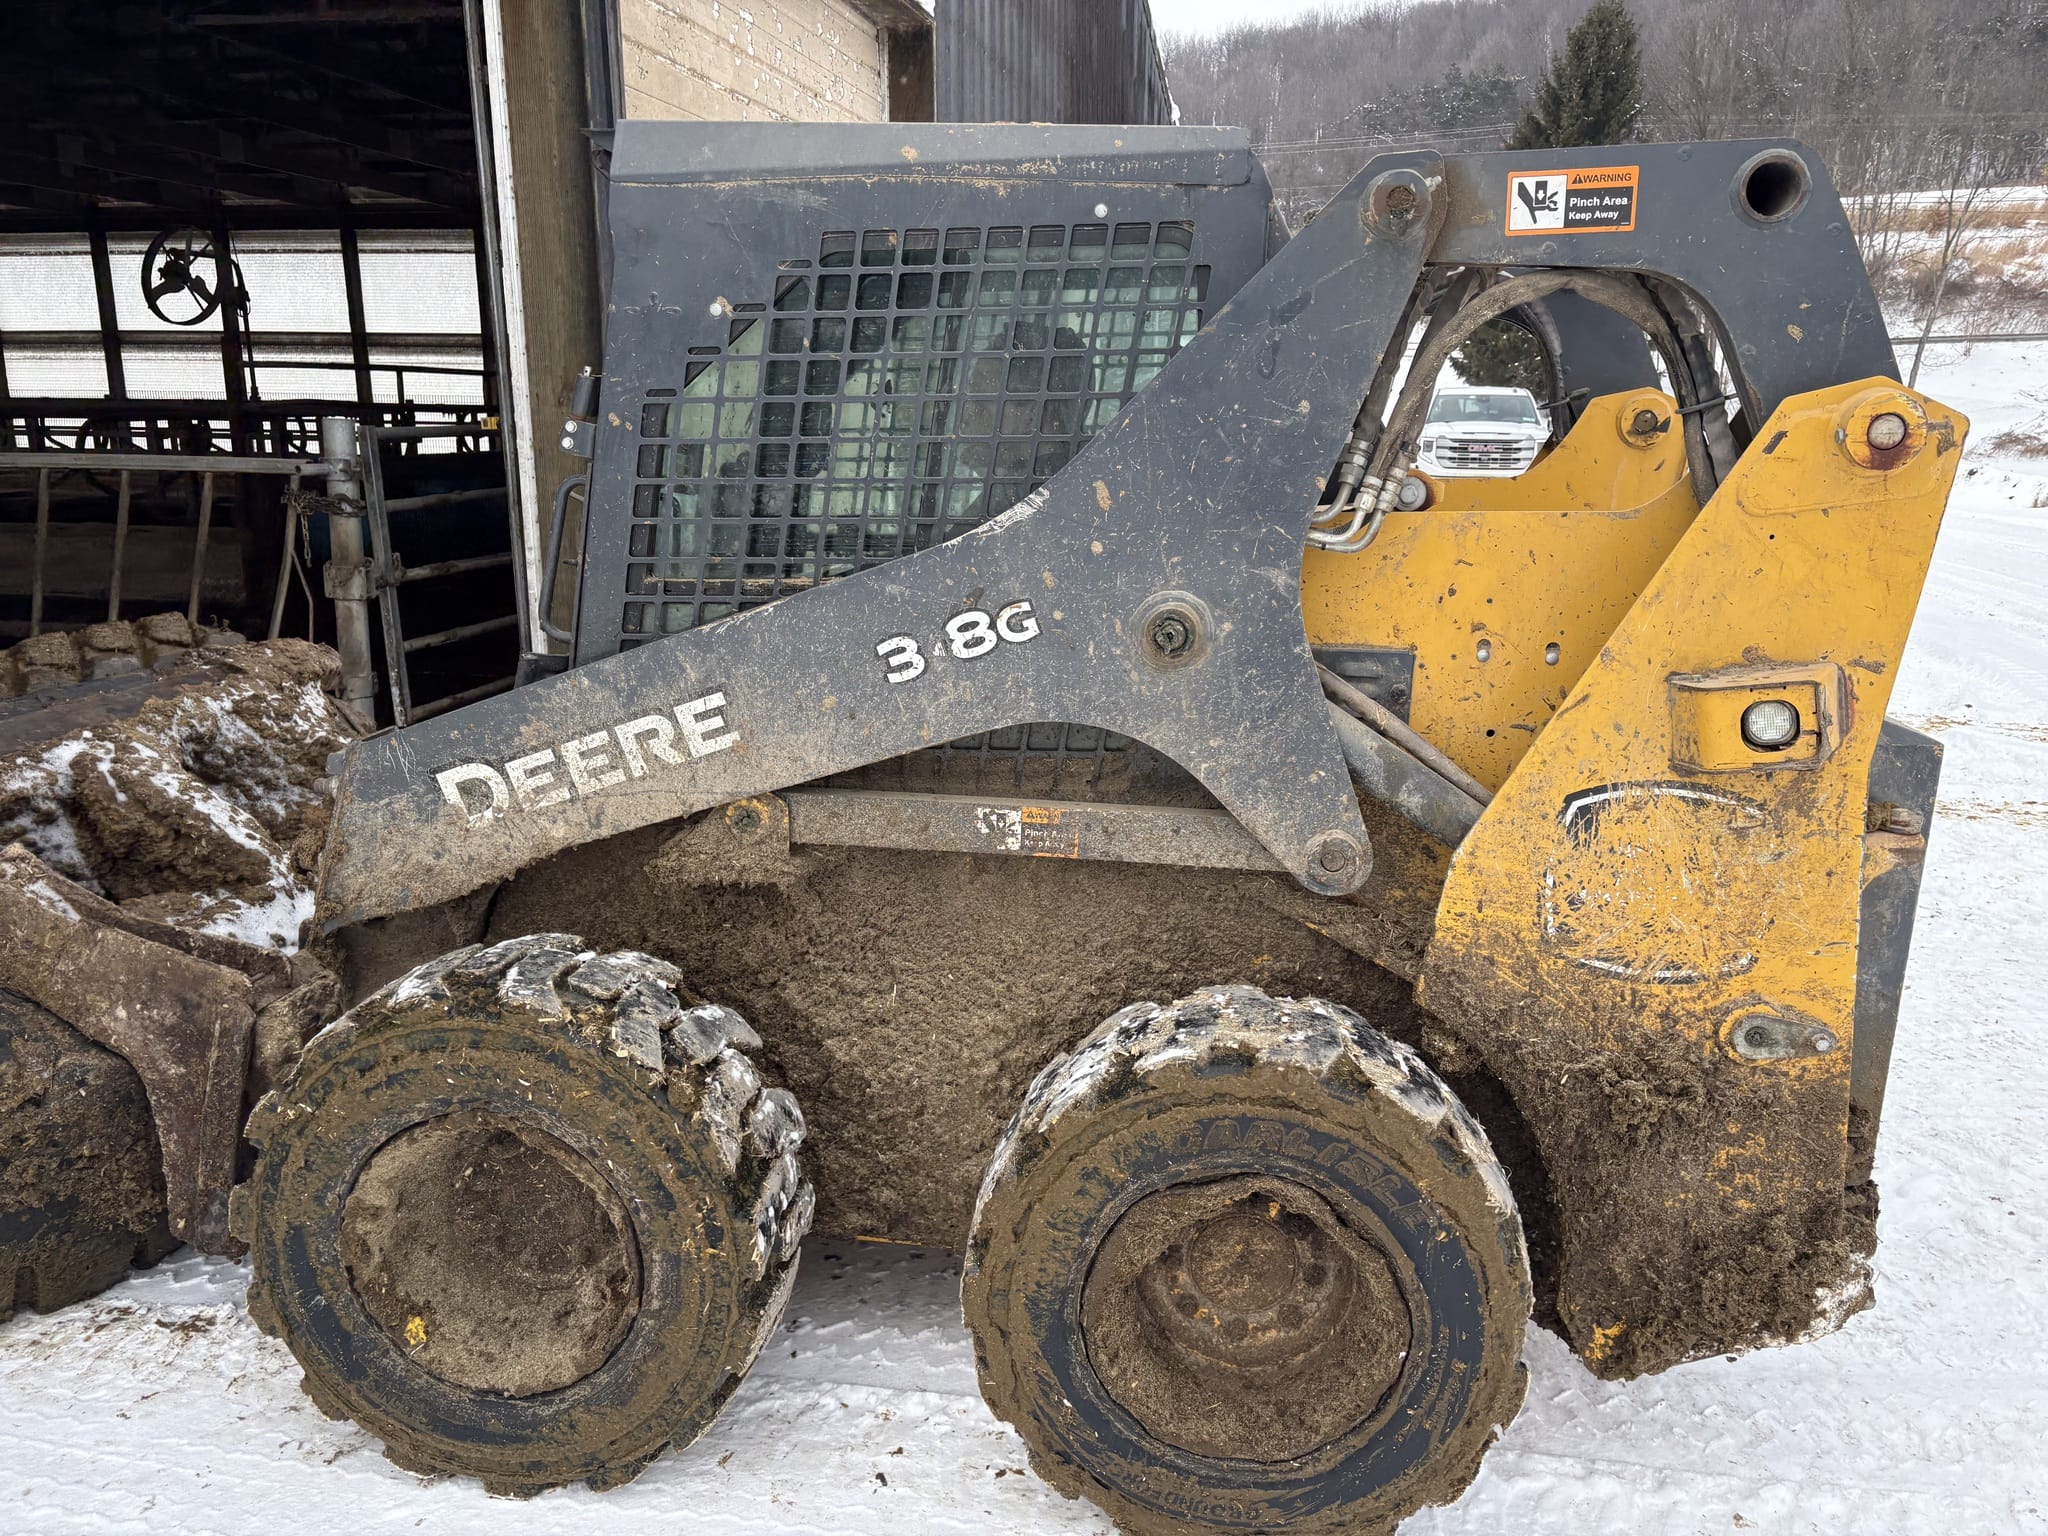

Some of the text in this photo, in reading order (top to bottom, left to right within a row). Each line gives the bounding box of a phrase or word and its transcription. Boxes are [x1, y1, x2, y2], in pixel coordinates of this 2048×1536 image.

[1583, 173, 1632, 184] WARNING
[1569, 196, 1628, 207] Pinch Area
[1568, 210, 1619, 221] Keep Away
[876, 601, 1041, 684] 38G
[436, 691, 740, 828] DEERE
